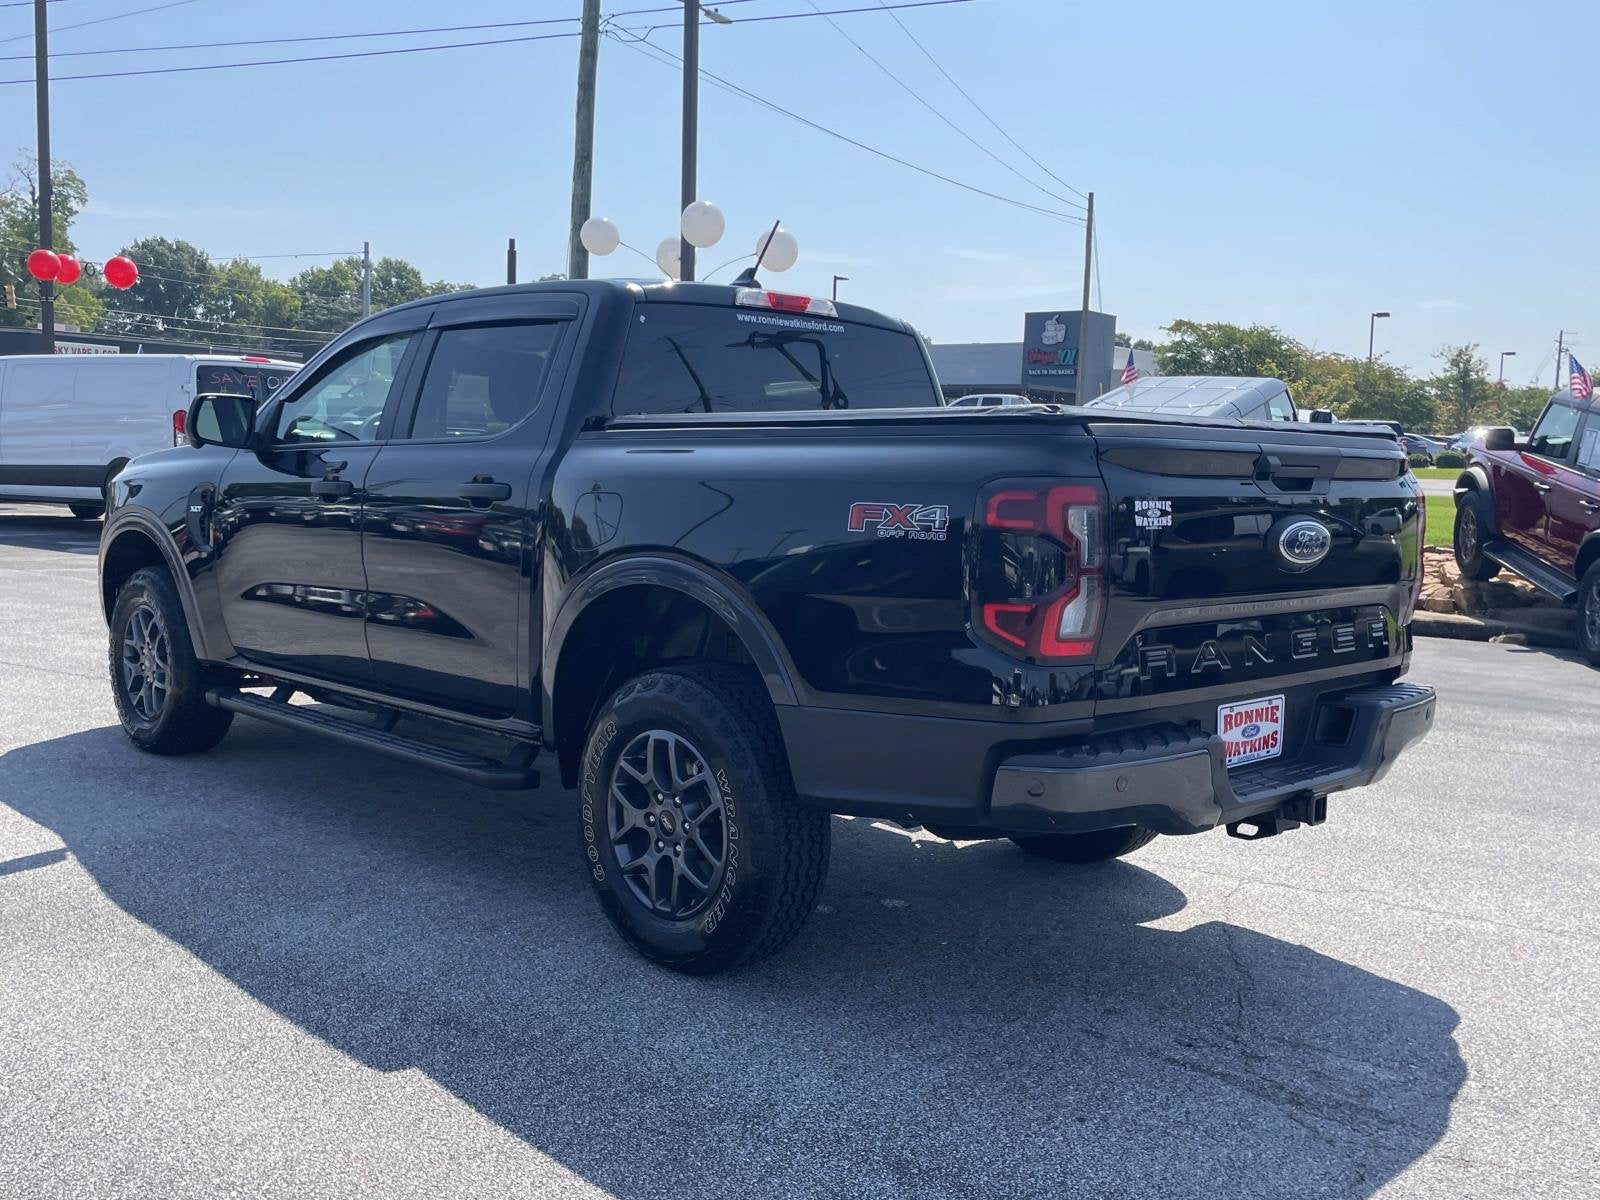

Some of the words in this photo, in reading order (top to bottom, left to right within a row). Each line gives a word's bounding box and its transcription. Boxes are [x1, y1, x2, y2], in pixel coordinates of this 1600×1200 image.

[737, 313, 844, 333] www.ronniewatkinsford.com
[210, 372, 257, 387] SAVE
[848, 502, 949, 532] FX4
[1135, 501, 1172, 512] RONNIE
[1135, 515, 1172, 527] WATKINS
[878, 530, 905, 538] OFF
[909, 531, 947, 540] ROAD
[1295, 530, 1323, 553] Ford
[1138, 618, 1389, 680] RANGER
[1223, 706, 1280, 734] RONNIE
[1224, 730, 1279, 758] WATKINS
[581, 720, 619, 882] GOODYEAR
[704, 768, 743, 934] WRANGLER
